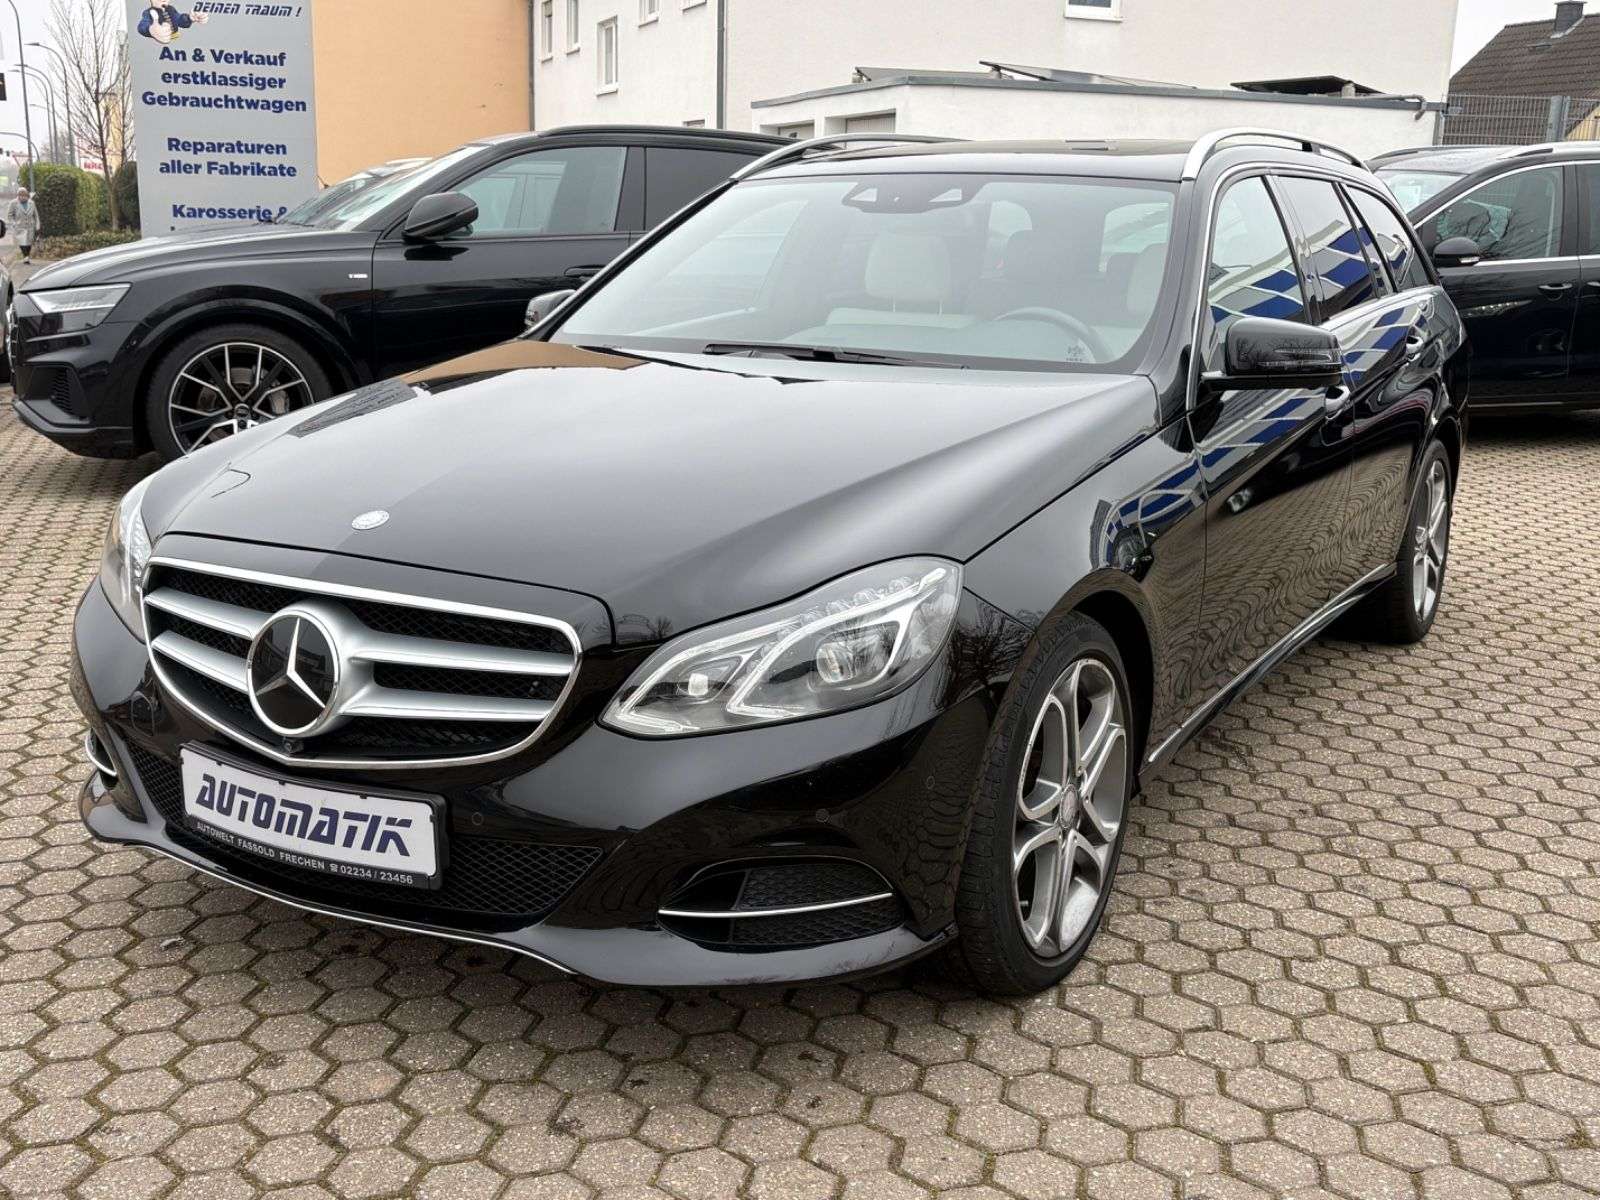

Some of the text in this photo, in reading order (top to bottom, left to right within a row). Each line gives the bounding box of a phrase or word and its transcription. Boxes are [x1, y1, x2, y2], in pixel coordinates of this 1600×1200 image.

[193, 1, 240, 15] DEINEN
[245, 4, 293, 17] TRAUM
[159, 46, 287, 67] An & Verkauf
[161, 71, 286, 90] erstklassiger
[142, 91, 307, 113] Gebrauchtwagen
[167, 137, 287, 155] Reparaturen
[159, 160, 297, 177] aller Fabrikate
[172, 204, 273, 219] Karosserie
[196, 773, 412, 857] AUTOMATIK
[238, 838, 275, 858] FASSOLD
[280, 851, 325, 870] FRECHEN
[340, 865, 372, 878] 02234
[380, 871, 413, 884] 23456
